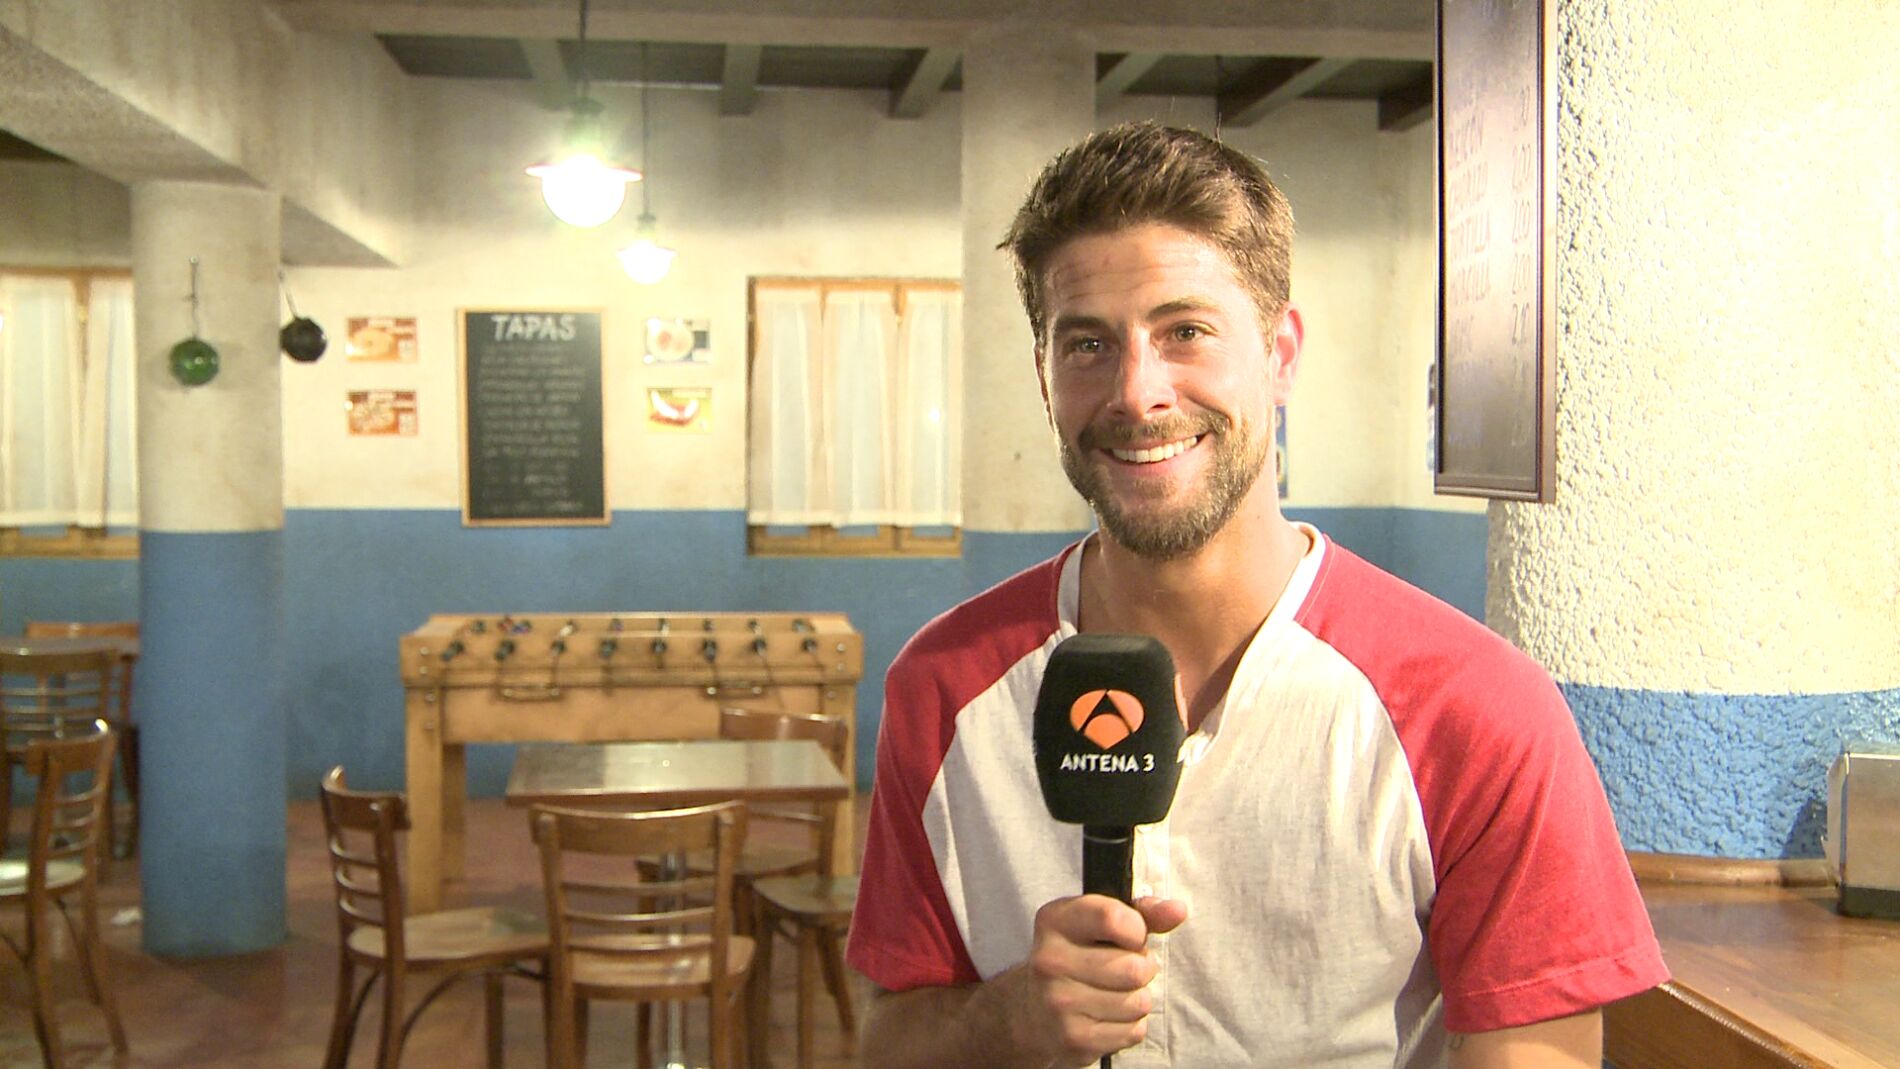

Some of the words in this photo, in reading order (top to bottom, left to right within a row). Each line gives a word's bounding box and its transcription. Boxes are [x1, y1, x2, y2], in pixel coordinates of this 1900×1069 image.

[490, 314, 577, 341] TAPAS
[1060, 753, 1139, 773] ANTENA
[1143, 752, 1155, 772] 3
